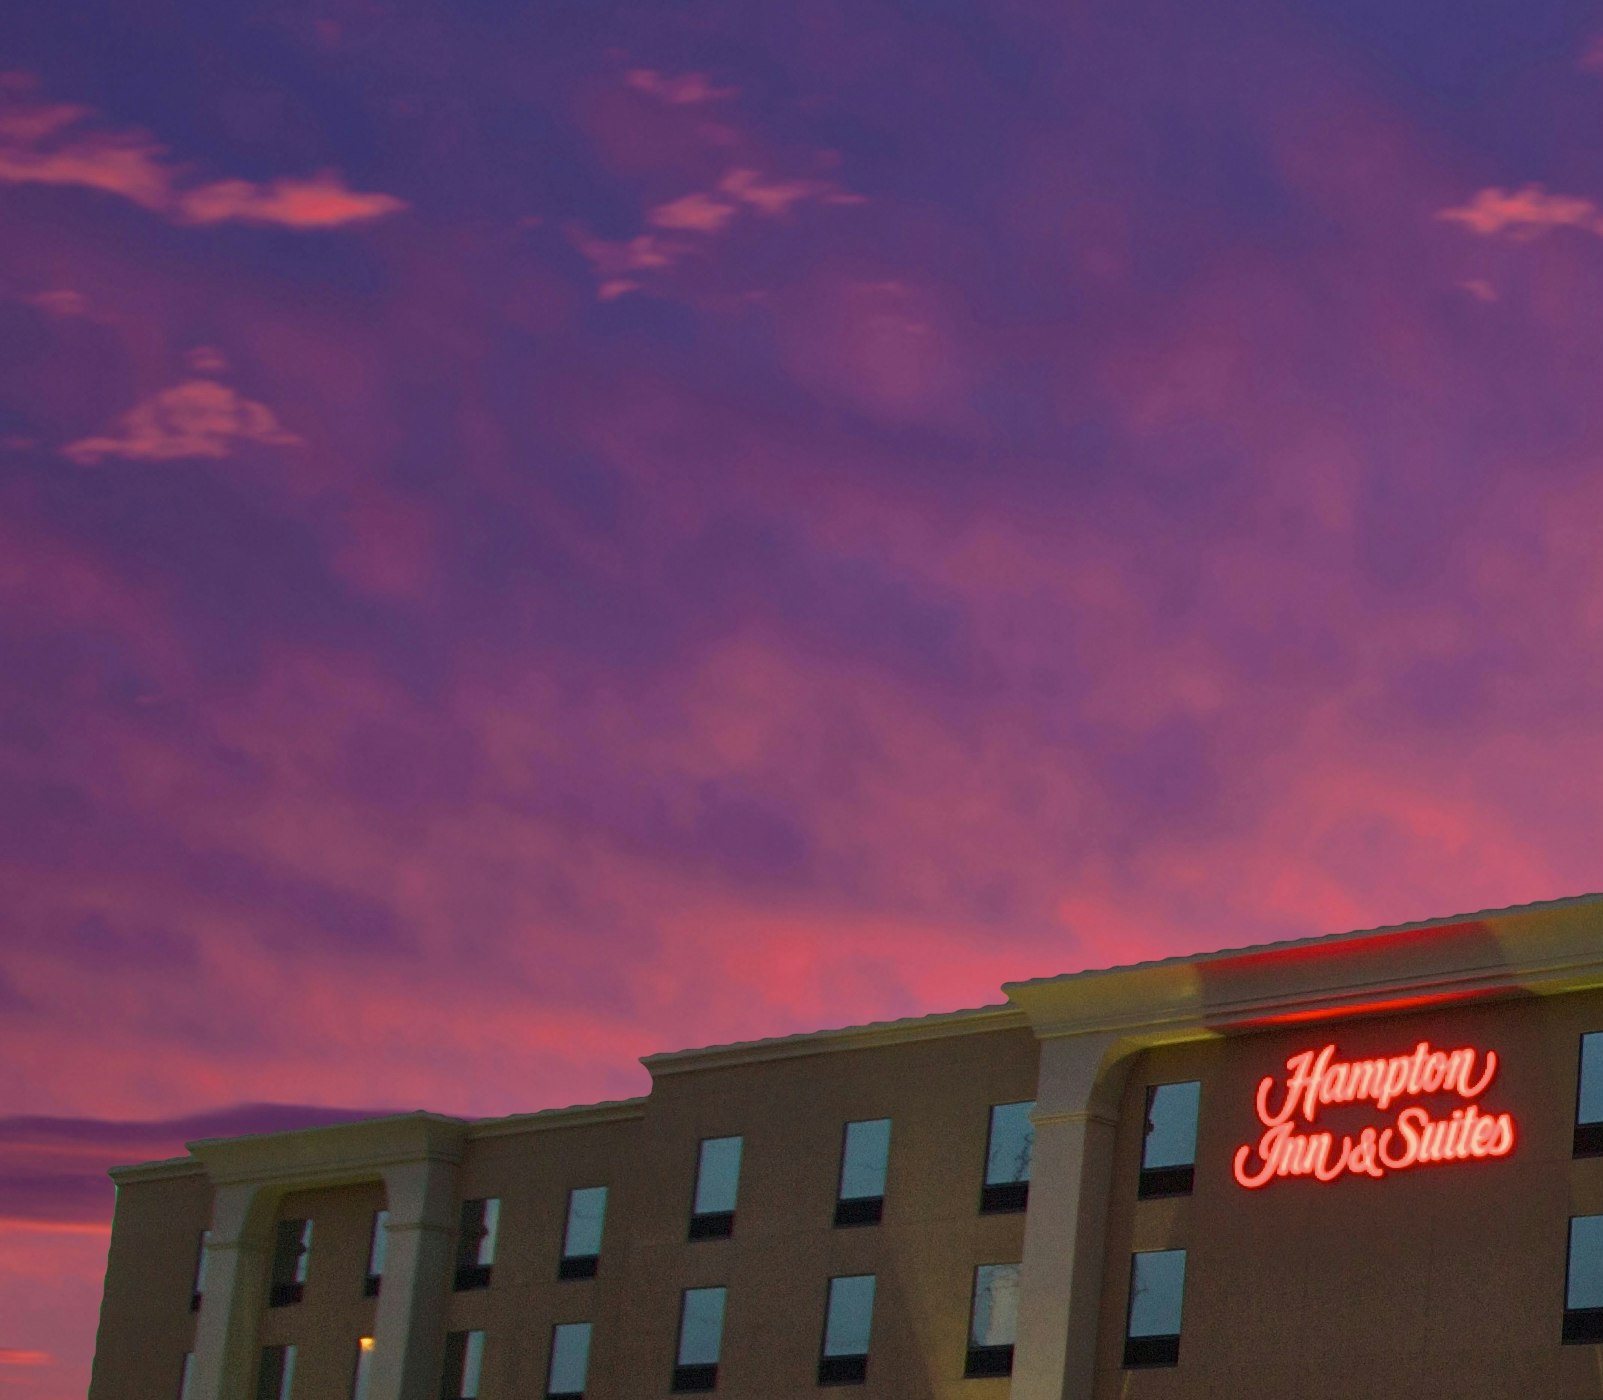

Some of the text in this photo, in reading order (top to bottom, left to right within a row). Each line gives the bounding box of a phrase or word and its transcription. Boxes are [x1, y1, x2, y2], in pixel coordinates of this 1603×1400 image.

[1256, 1041, 1497, 1127] Hampton
[1234, 1104, 1514, 1188] Inn & Suites
